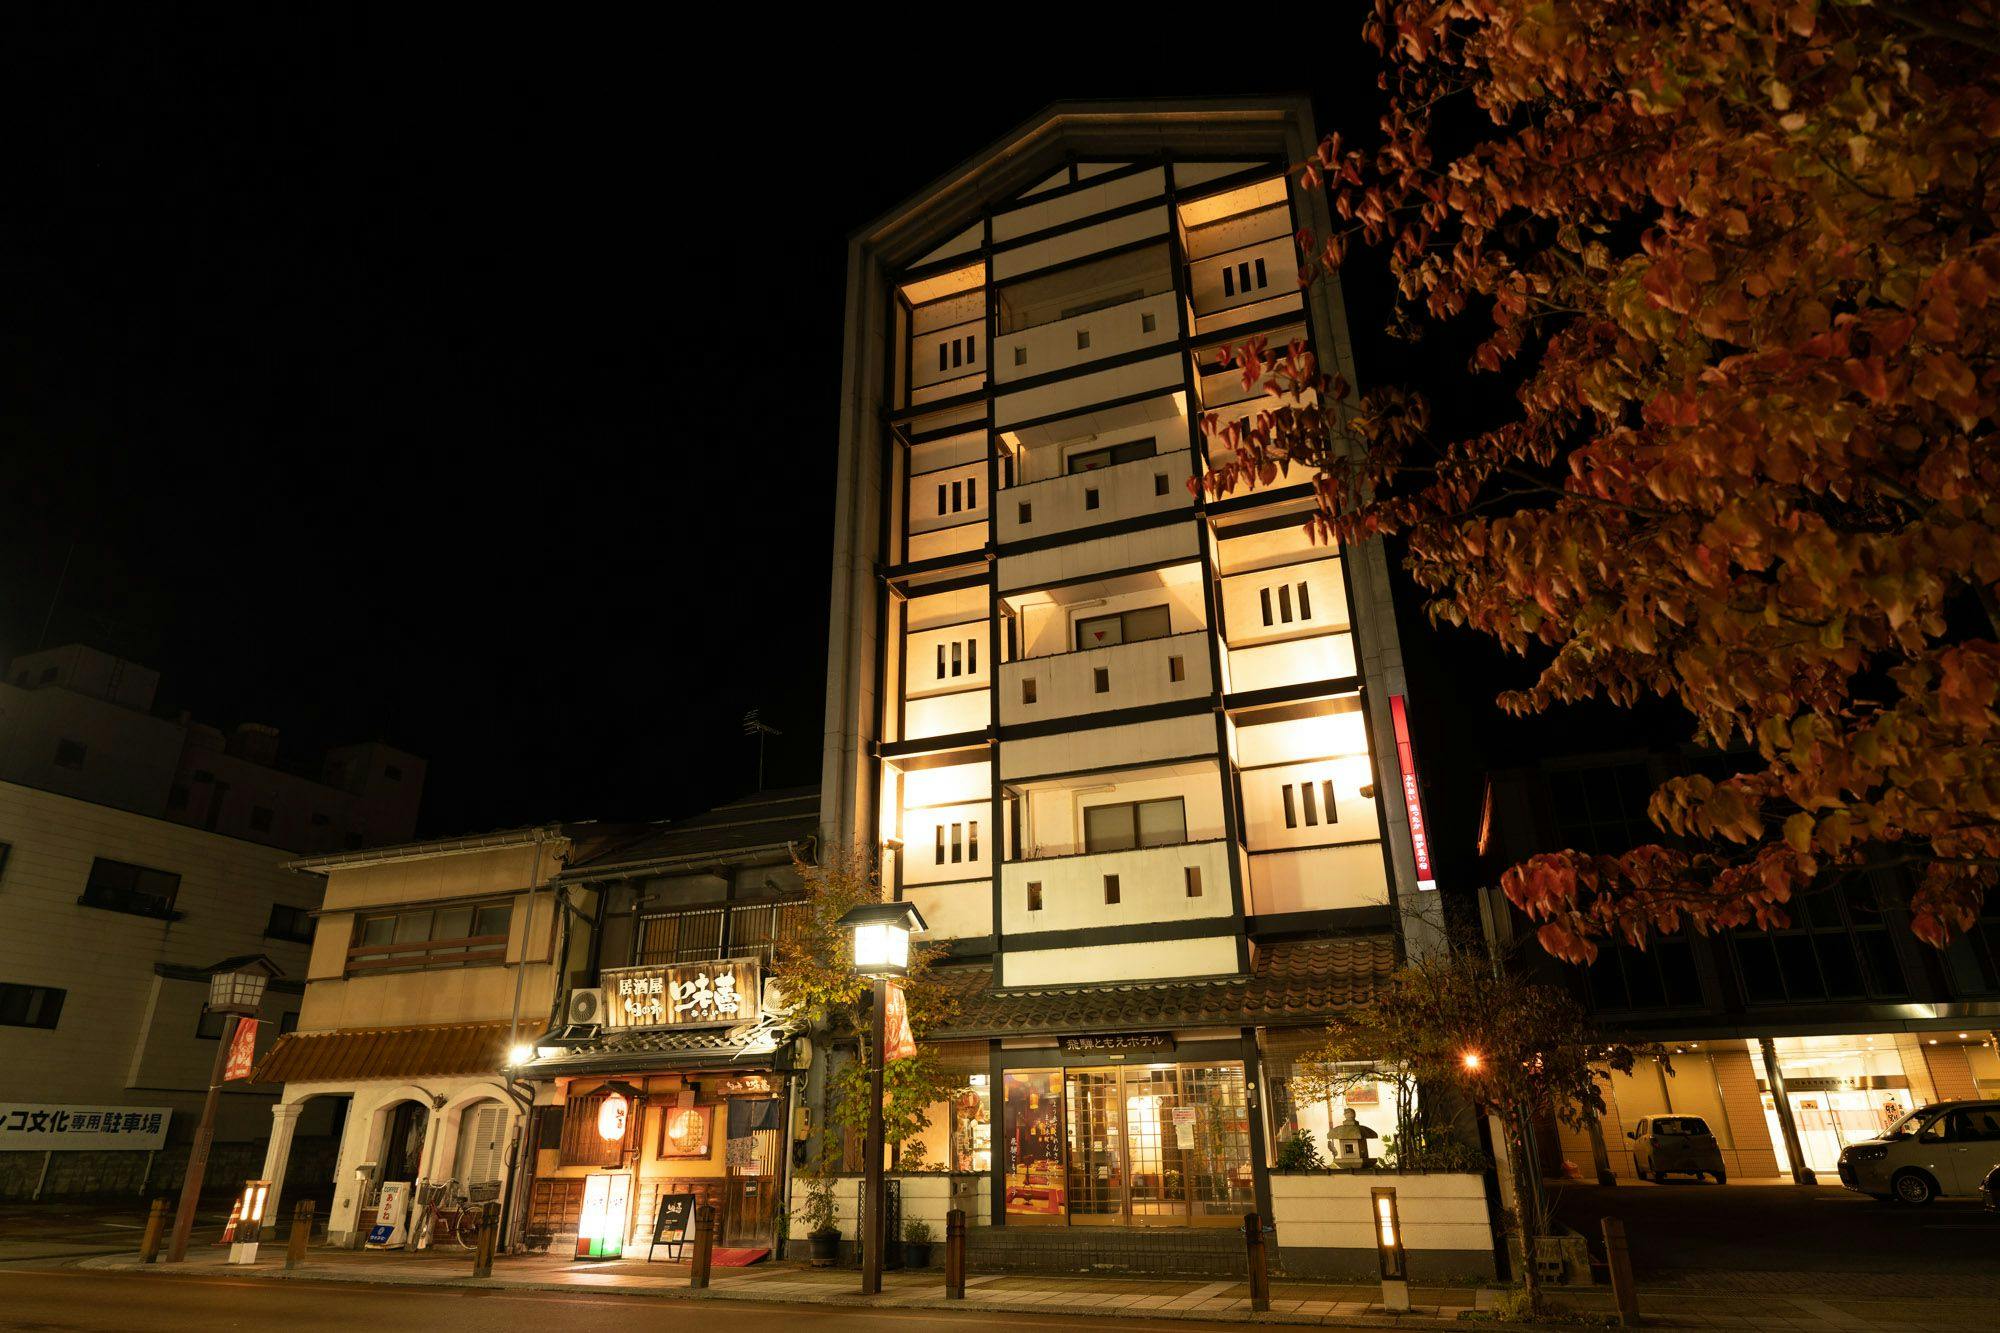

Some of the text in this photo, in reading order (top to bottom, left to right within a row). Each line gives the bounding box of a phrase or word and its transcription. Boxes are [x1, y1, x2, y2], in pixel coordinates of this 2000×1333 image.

[620, 977, 663, 996] 居酒屋
[1066, 1036, 1164, 1050] 飛騨ともえホテル
[382, 1193, 394, 1220] あかね
